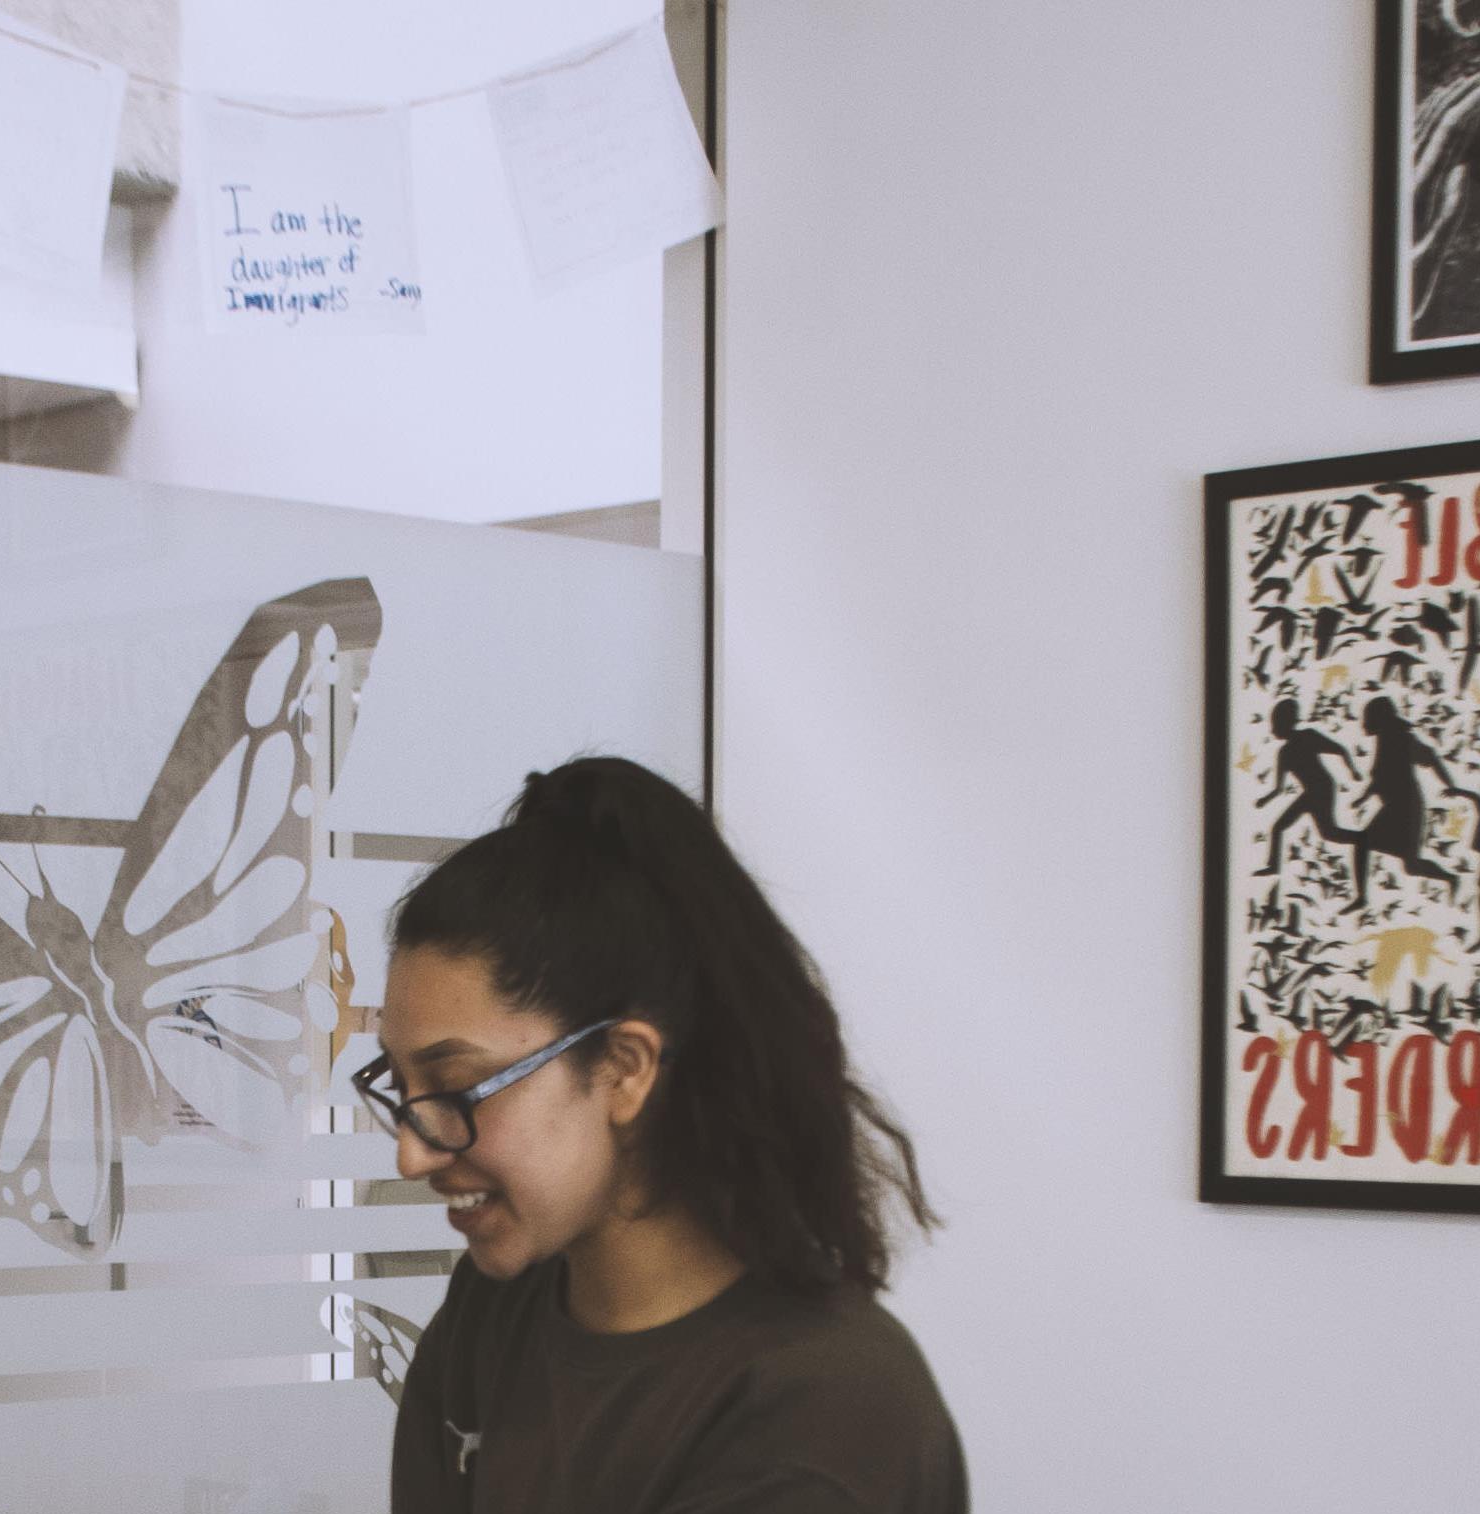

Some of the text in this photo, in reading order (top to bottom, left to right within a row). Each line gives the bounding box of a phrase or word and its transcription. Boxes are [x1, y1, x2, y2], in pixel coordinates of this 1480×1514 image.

[220, 185, 364, 239] I am the
[231, 244, 360, 294] daughter of
